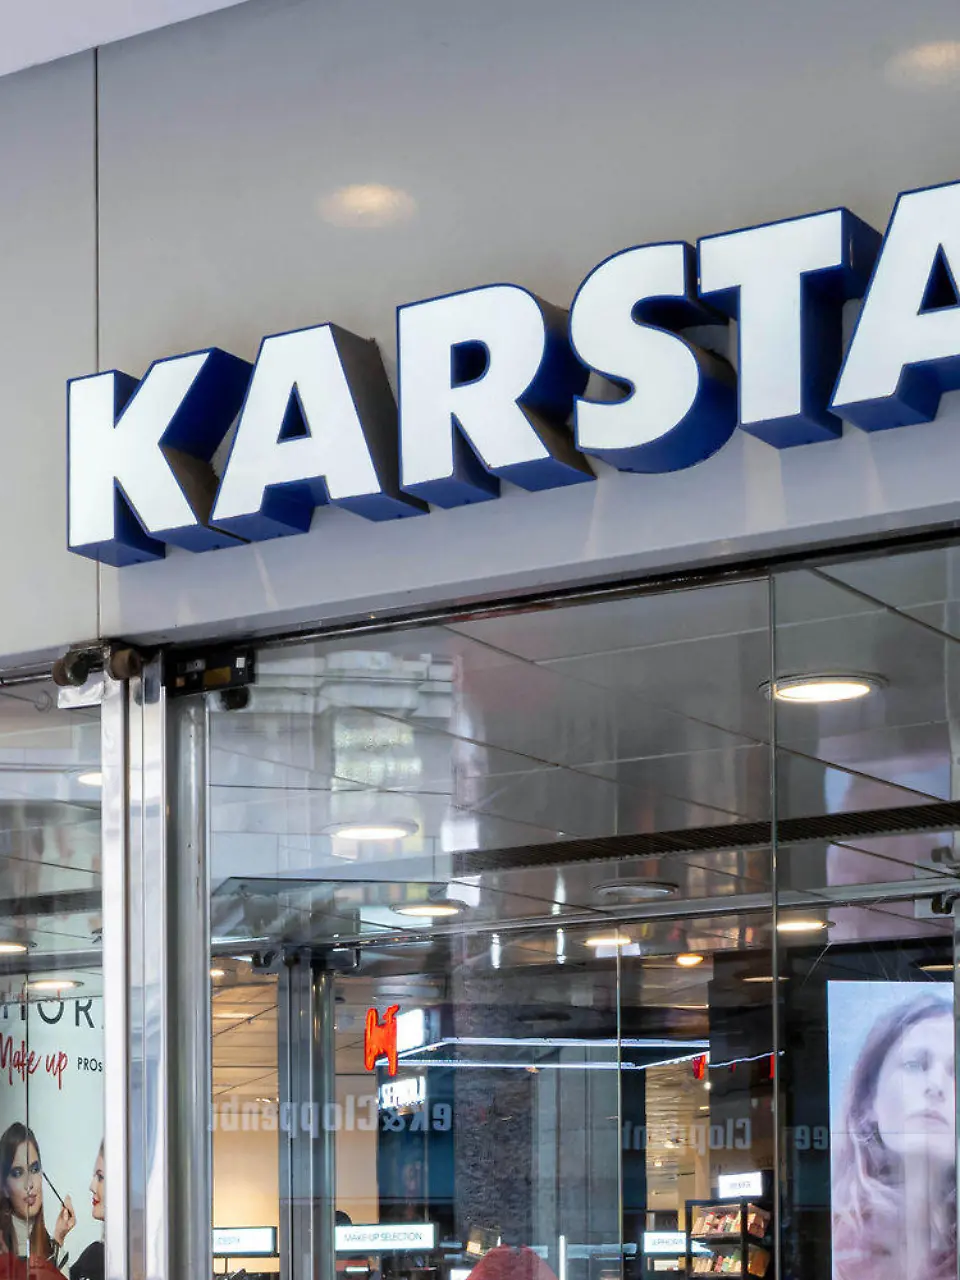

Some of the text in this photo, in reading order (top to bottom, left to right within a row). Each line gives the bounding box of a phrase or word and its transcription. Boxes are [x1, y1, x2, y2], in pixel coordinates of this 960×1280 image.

[67, 180, 960, 552] KARSTA
[46, 1051, 68, 1090] up
[77, 1057, 103, 1072] PROs
[381, 1231, 423, 1241] SELECTION
